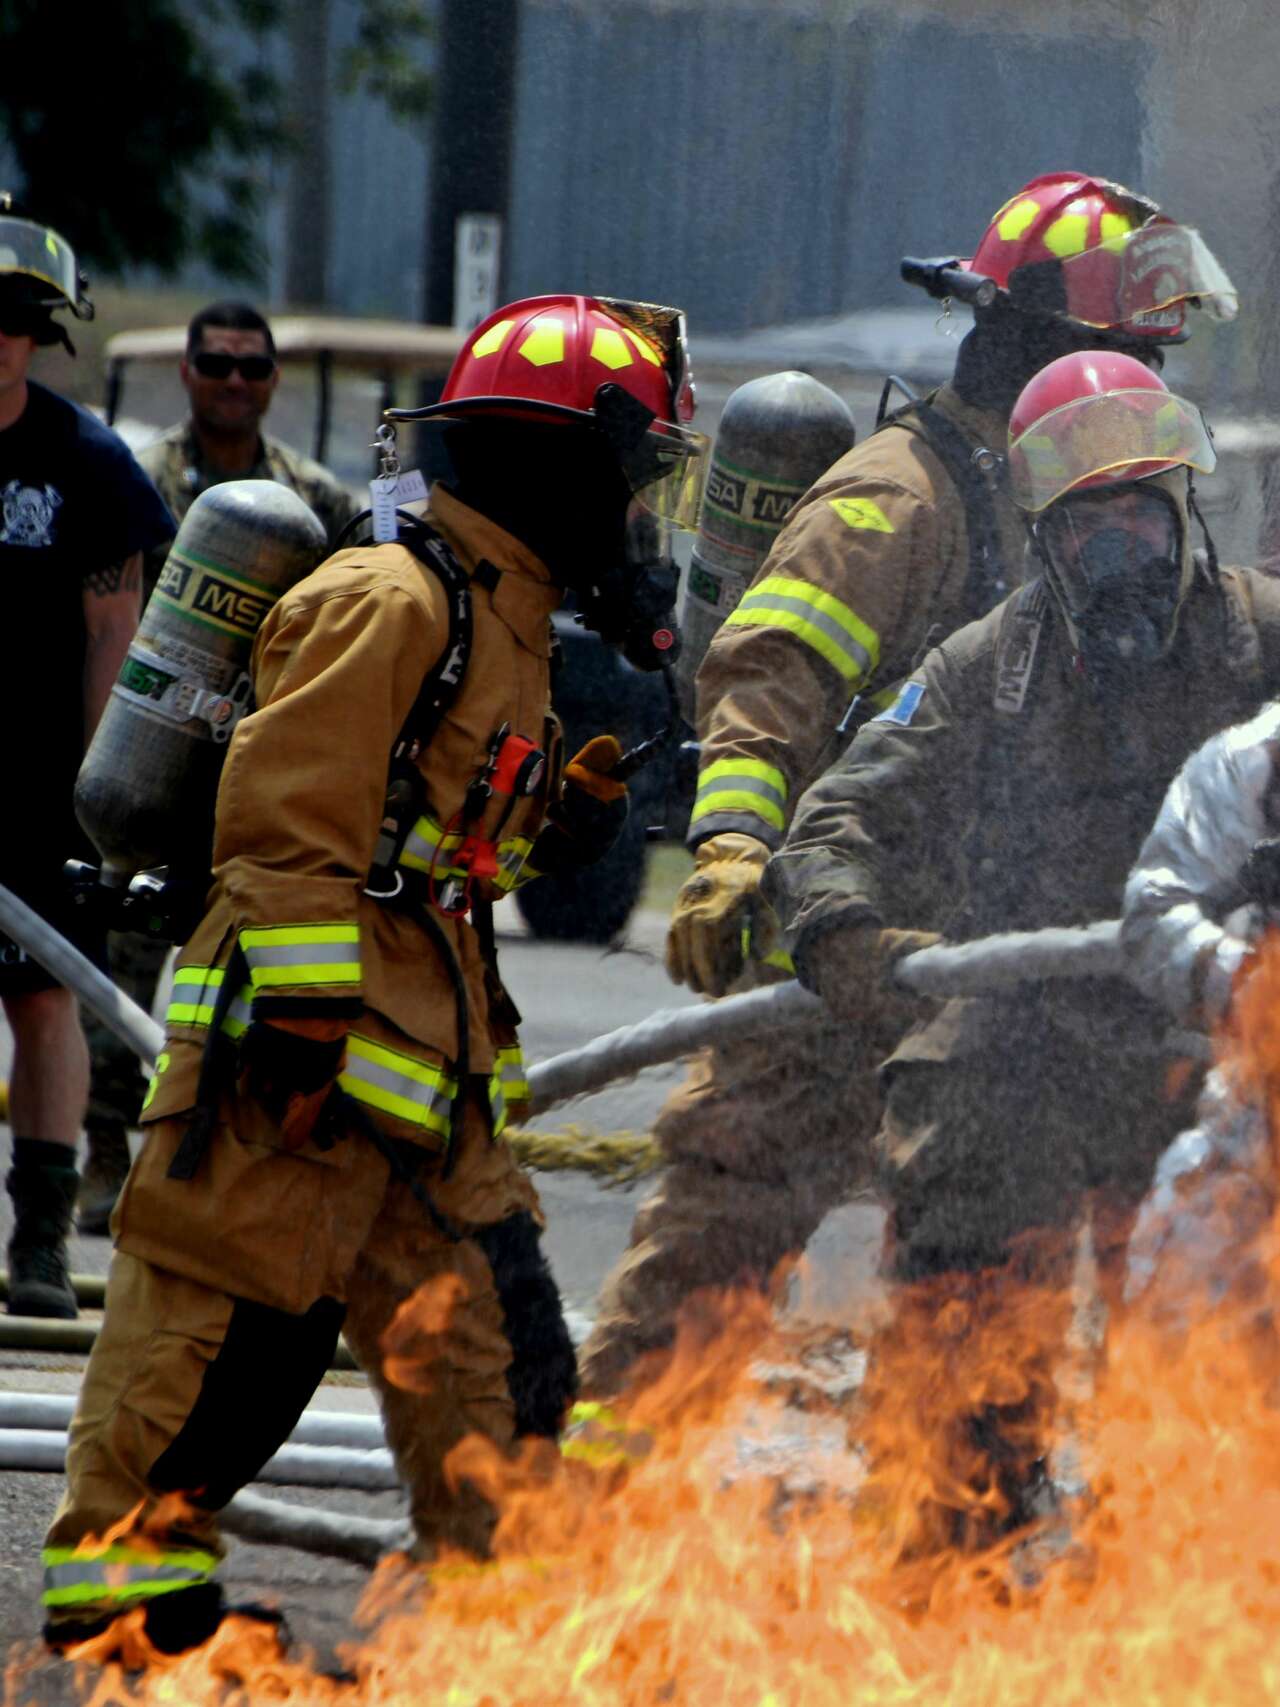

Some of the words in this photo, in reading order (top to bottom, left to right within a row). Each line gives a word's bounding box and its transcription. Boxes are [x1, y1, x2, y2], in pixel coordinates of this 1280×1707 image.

[706, 473, 738, 509] SA
[158, 563, 181, 596] SA
[200, 583, 263, 626] MS
